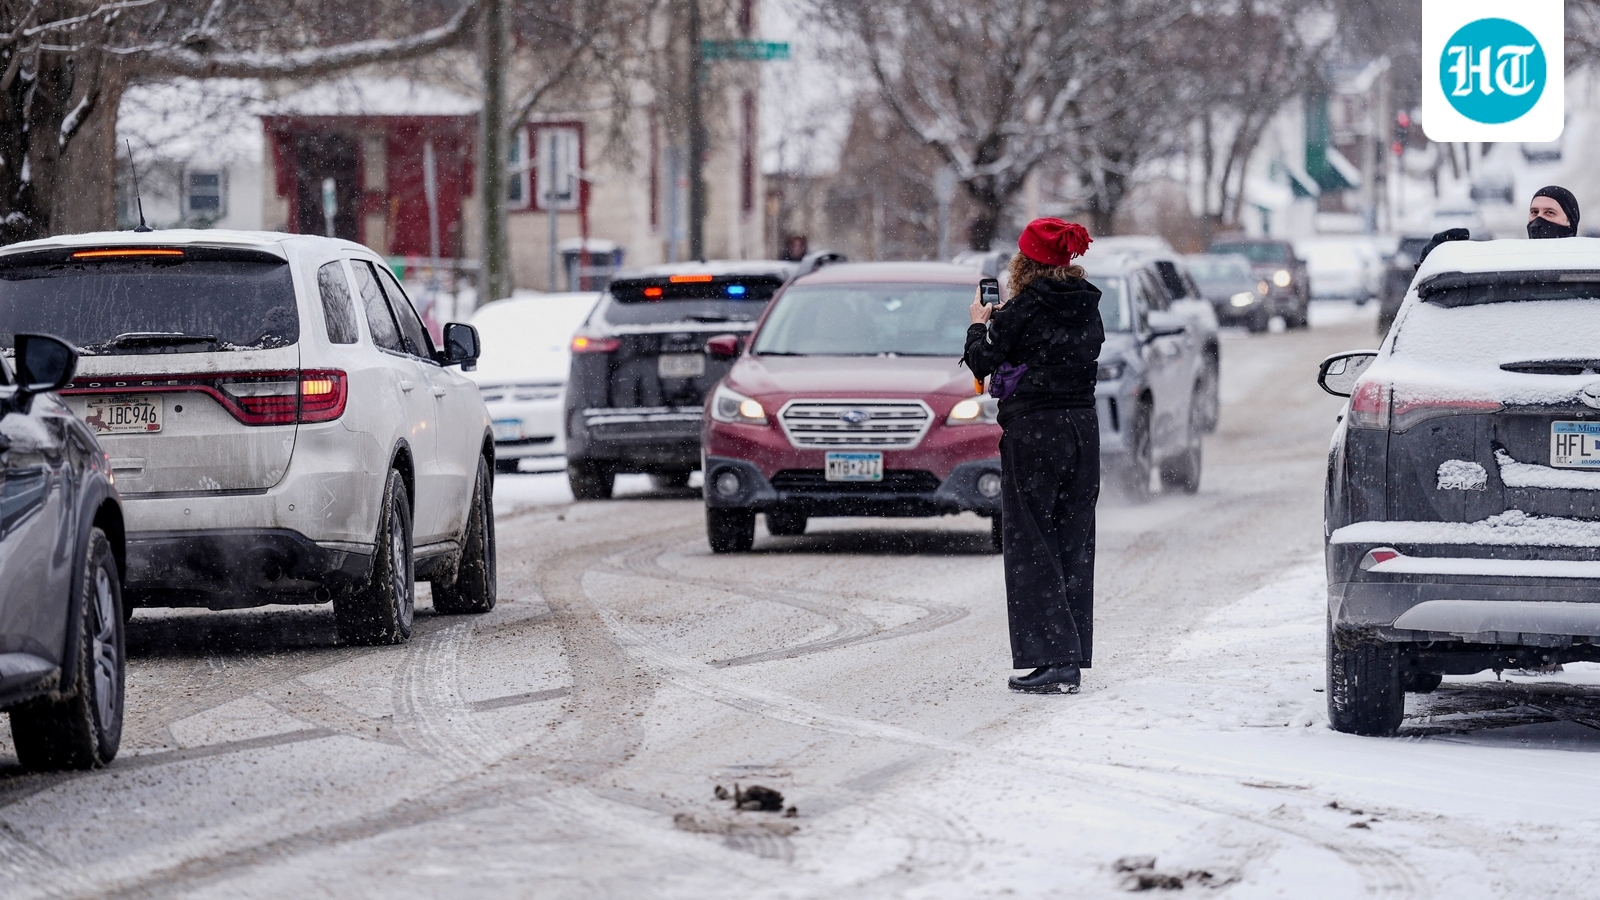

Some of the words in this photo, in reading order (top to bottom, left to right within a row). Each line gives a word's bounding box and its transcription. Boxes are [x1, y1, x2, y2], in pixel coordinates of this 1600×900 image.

[63, 380, 178, 389] DODGE
[107, 406, 157, 425] 1BC946
[1556, 434, 1591, 456] HFL
[858, 460, 879, 475] 217
[1436, 481, 1487, 492] RAV4
